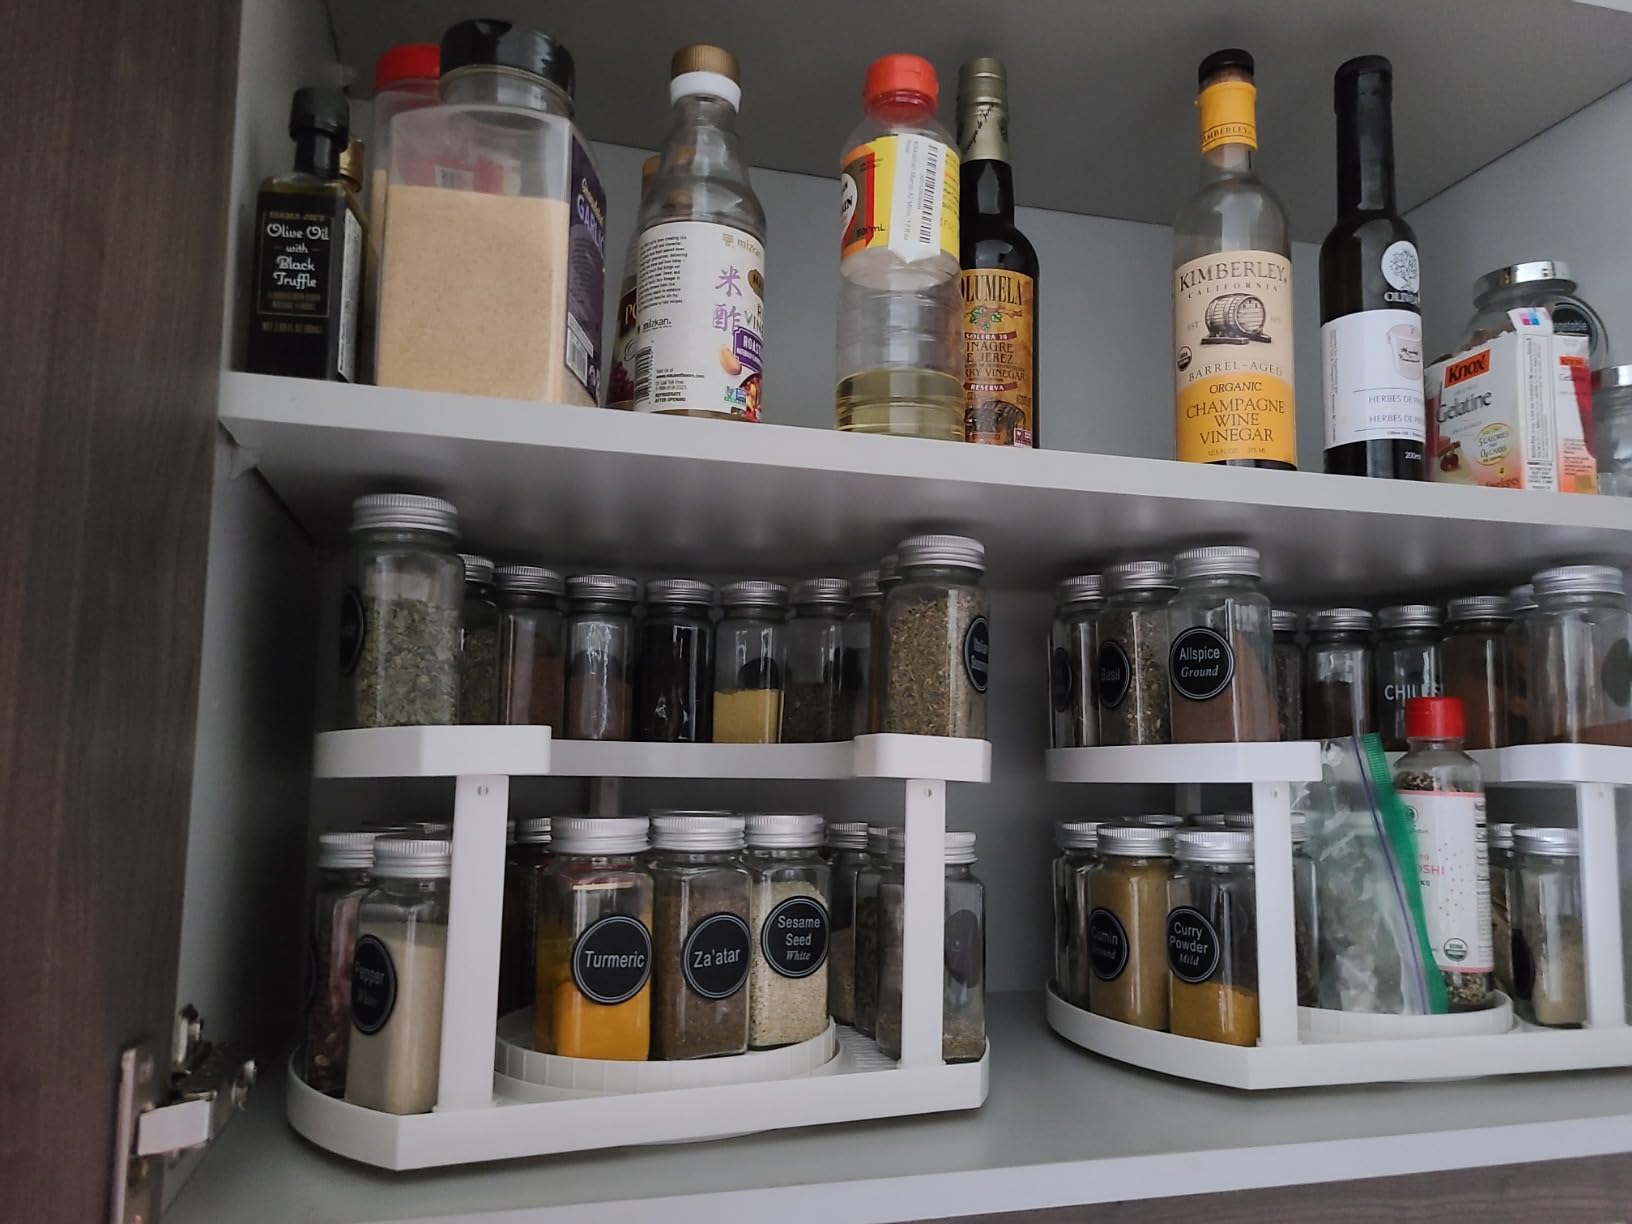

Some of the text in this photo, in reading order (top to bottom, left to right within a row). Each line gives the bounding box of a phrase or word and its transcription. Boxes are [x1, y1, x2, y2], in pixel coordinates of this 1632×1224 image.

[267, 223, 330, 240] Olive Oil
[577, 193, 605, 259] GARLIC
[286, 241, 309, 254] with
[276, 255, 316, 272] Black
[273, 271, 317, 290] Truffle
[1180, 261, 1284, 292] KIMBERLEY
[961, 274, 1023, 306] OLUMELA
[1188, 282, 1279, 300] CALIFORNIA
[714, 264, 742, 337] 米酢
[965, 333, 997, 341] SOLERA
[966, 341, 1014, 354] INAGRE
[979, 352, 1014, 365] JEREZ
[985, 368, 1026, 382] VINEGAR
[1189, 360, 1283, 382] BARREL-AGED
[1449, 356, 1485, 383] Knox
[970, 383, 1005, 392] RESERVA
[1209, 381, 1263, 394] ORGANIC
[1368, 394, 1402, 404] HERBES
[1436, 391, 1492, 423] Gelatine
[1186, 398, 1285, 419] CHAMPAGNE
[1214, 412, 1260, 429] WINE
[1369, 414, 1403, 424] HERBES
[1199, 427, 1275, 445] VINEGAR
[1179, 645, 1221, 663] Allspice
[1180, 664, 1219, 678] Ground
[777, 915, 821, 929] Sesame
[785, 932, 812, 947] Seed
[1174, 921, 1203, 942] Curry
[1169, 935, 1209, 954] Powder
[584, 950, 645, 969] Turmeric
[693, 947, 741, 969] Za'atar
[786, 950, 811, 961] White
[1179, 953, 1200, 966] Mild
